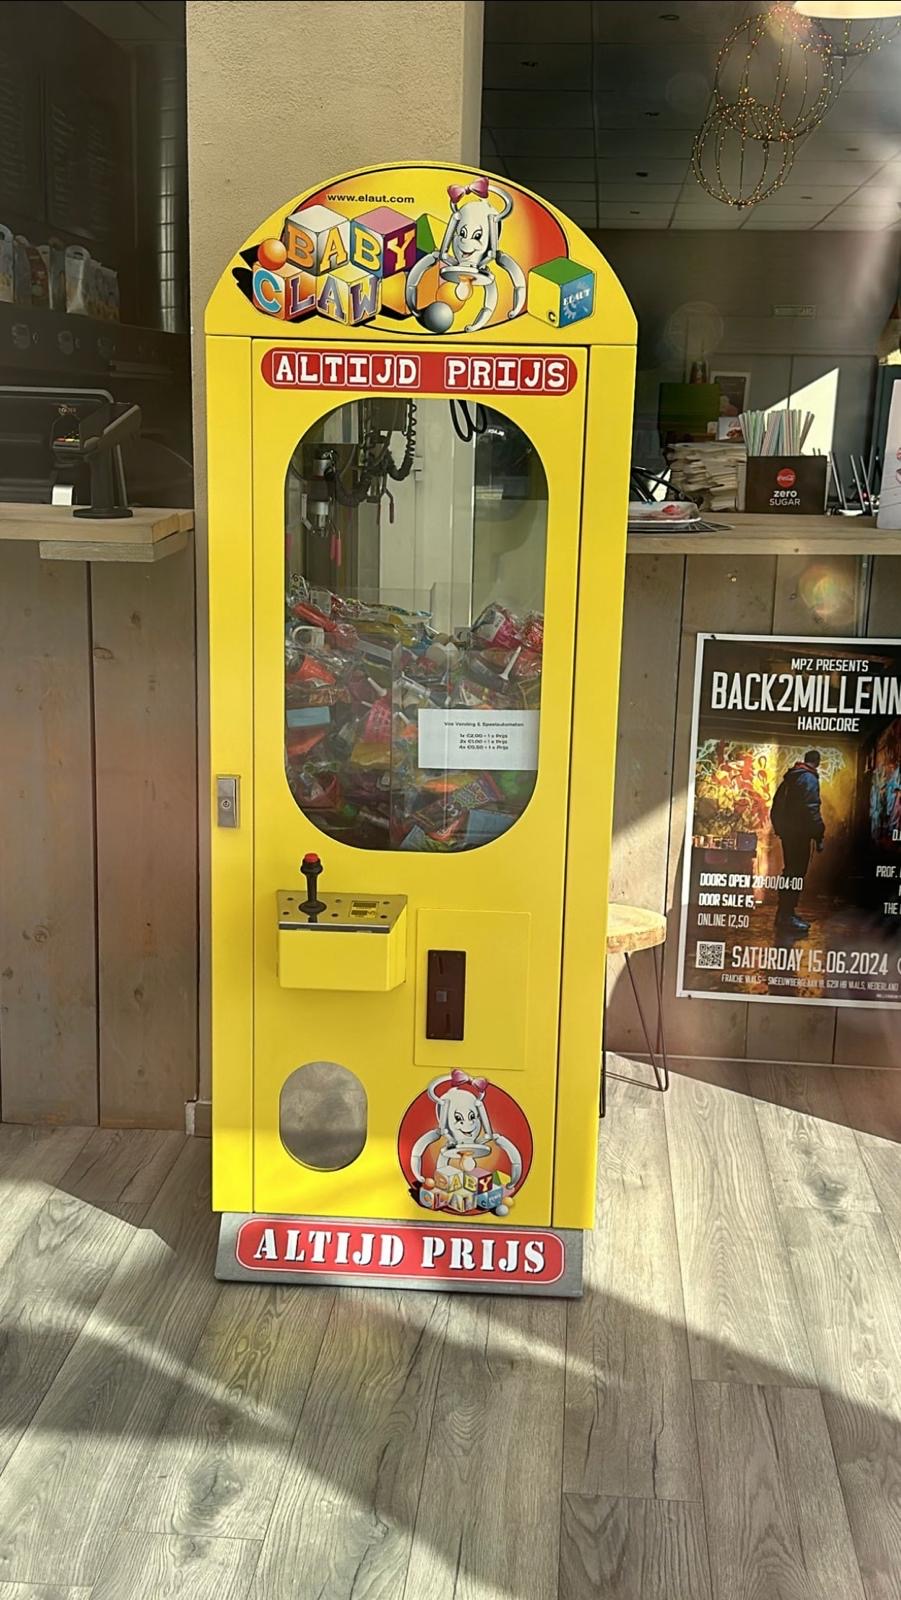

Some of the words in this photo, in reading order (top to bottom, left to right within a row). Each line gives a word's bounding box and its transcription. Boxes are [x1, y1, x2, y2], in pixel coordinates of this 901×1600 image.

[327, 194, 415, 204] www.elaut.com
[288, 223, 416, 272] BABY
[252, 270, 381, 325] CLAW
[275, 354, 419, 387] ALTIJD
[447, 358, 566, 390] PRIJS
[791, 658, 813, 671] MPZ
[816, 660, 869, 672] PRESENTS
[797, 716, 860, 732] HARDCORE
[876, 866, 898, 878] PROF.
[700, 873, 728, 886] DOORS
[728, 874, 750, 888] OPEN
[698, 893, 720, 906] DOOR
[722, 894, 744, 908] SALE
[884, 902, 898, 914] THE
[698, 913, 726, 927] ONLINE
[728, 914, 749, 928] 12,50
[732, 946, 803, 972] SATURDAY
[808, 949, 888, 976] 15.06.2024
[254, 1228, 404, 1267] ALTIJD
[421, 1236, 544, 1273] PRIJS
